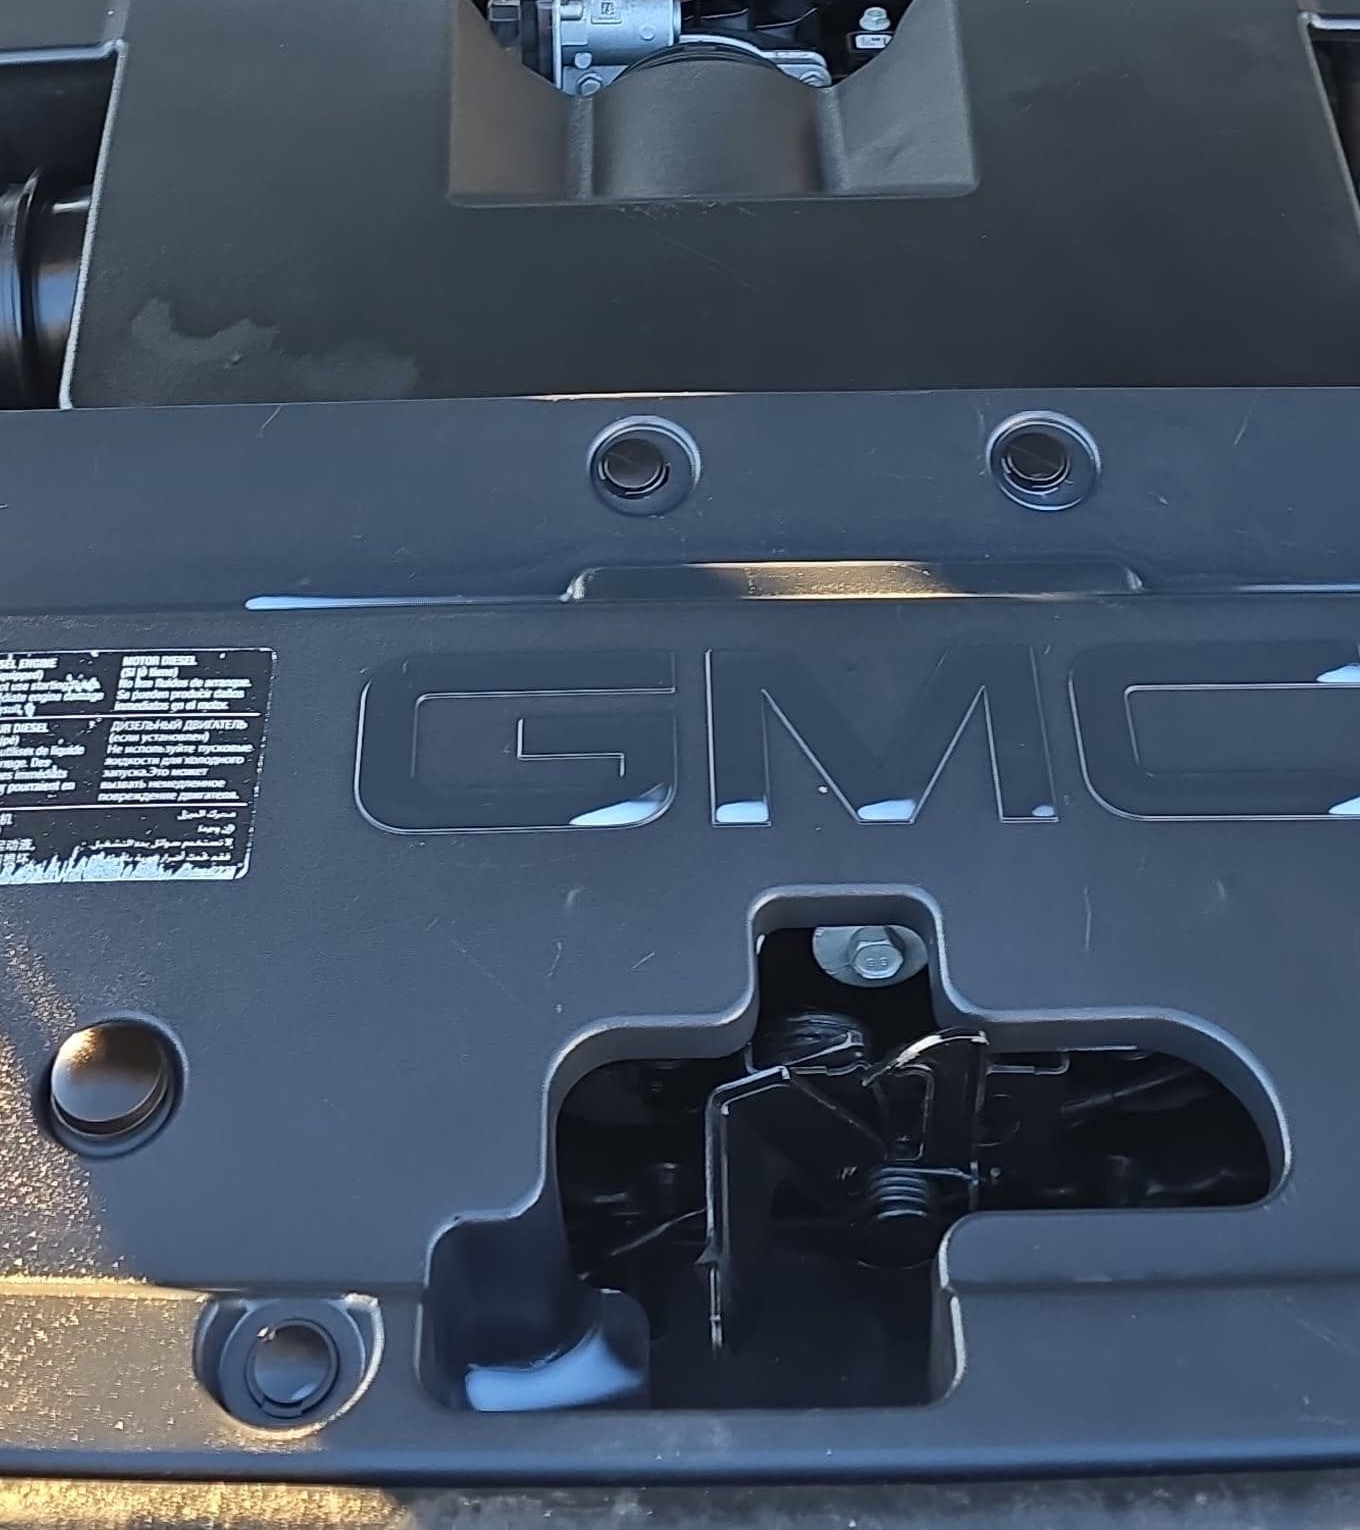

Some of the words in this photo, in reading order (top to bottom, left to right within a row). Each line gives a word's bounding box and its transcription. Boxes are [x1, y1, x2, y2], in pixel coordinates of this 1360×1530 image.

[18, 657, 58, 669] ENGINE
[122, 656, 160, 666] MOTOR
[161, 655, 198, 666] DIESEL
[11, 682, 29, 691] use
[118, 678, 133, 688] No
[155, 678, 189, 688] fluidos
[189, 678, 204, 688] de
[204, 678, 252, 689] arranque.
[28, 691, 62, 703] engine
[63, 691, 104, 703] damage
[116, 690, 130, 700] Se
[131, 689, 169, 701] pueden
[170, 689, 212, 701] producir
[170, 701, 184, 710] en
[185, 700, 196, 710] el
[13, 722, 50, 733] DIESEL
[110, 719, 182, 732] ДИЗЕЛЬНЫЙ
[183, 719, 248, 732] ДВИГАТЕЛЬ
[109, 733, 140, 744] (если
[141, 732, 210, 744] установлен)
[0, 747, 34, 757] utiliser
[35, 746, 49, 756] de
[50, 745, 85, 757] liquide
[107, 745, 123, 754] Не
[124, 744, 196, 755] используйте
[30, 757, 52, 768] Des
[104, 756, 160, 766] жидкости
[160, 756, 182, 766] для
[183, 756, 245, 766] холодного
[171, 767, 209, 776] может
[7, 781, 60, 794] pourraient
[61, 781, 75, 790] en
[100, 780, 147, 789] вызвать
[148, 779, 226, 790] немедленное
[97, 792, 177, 802] повреждение
